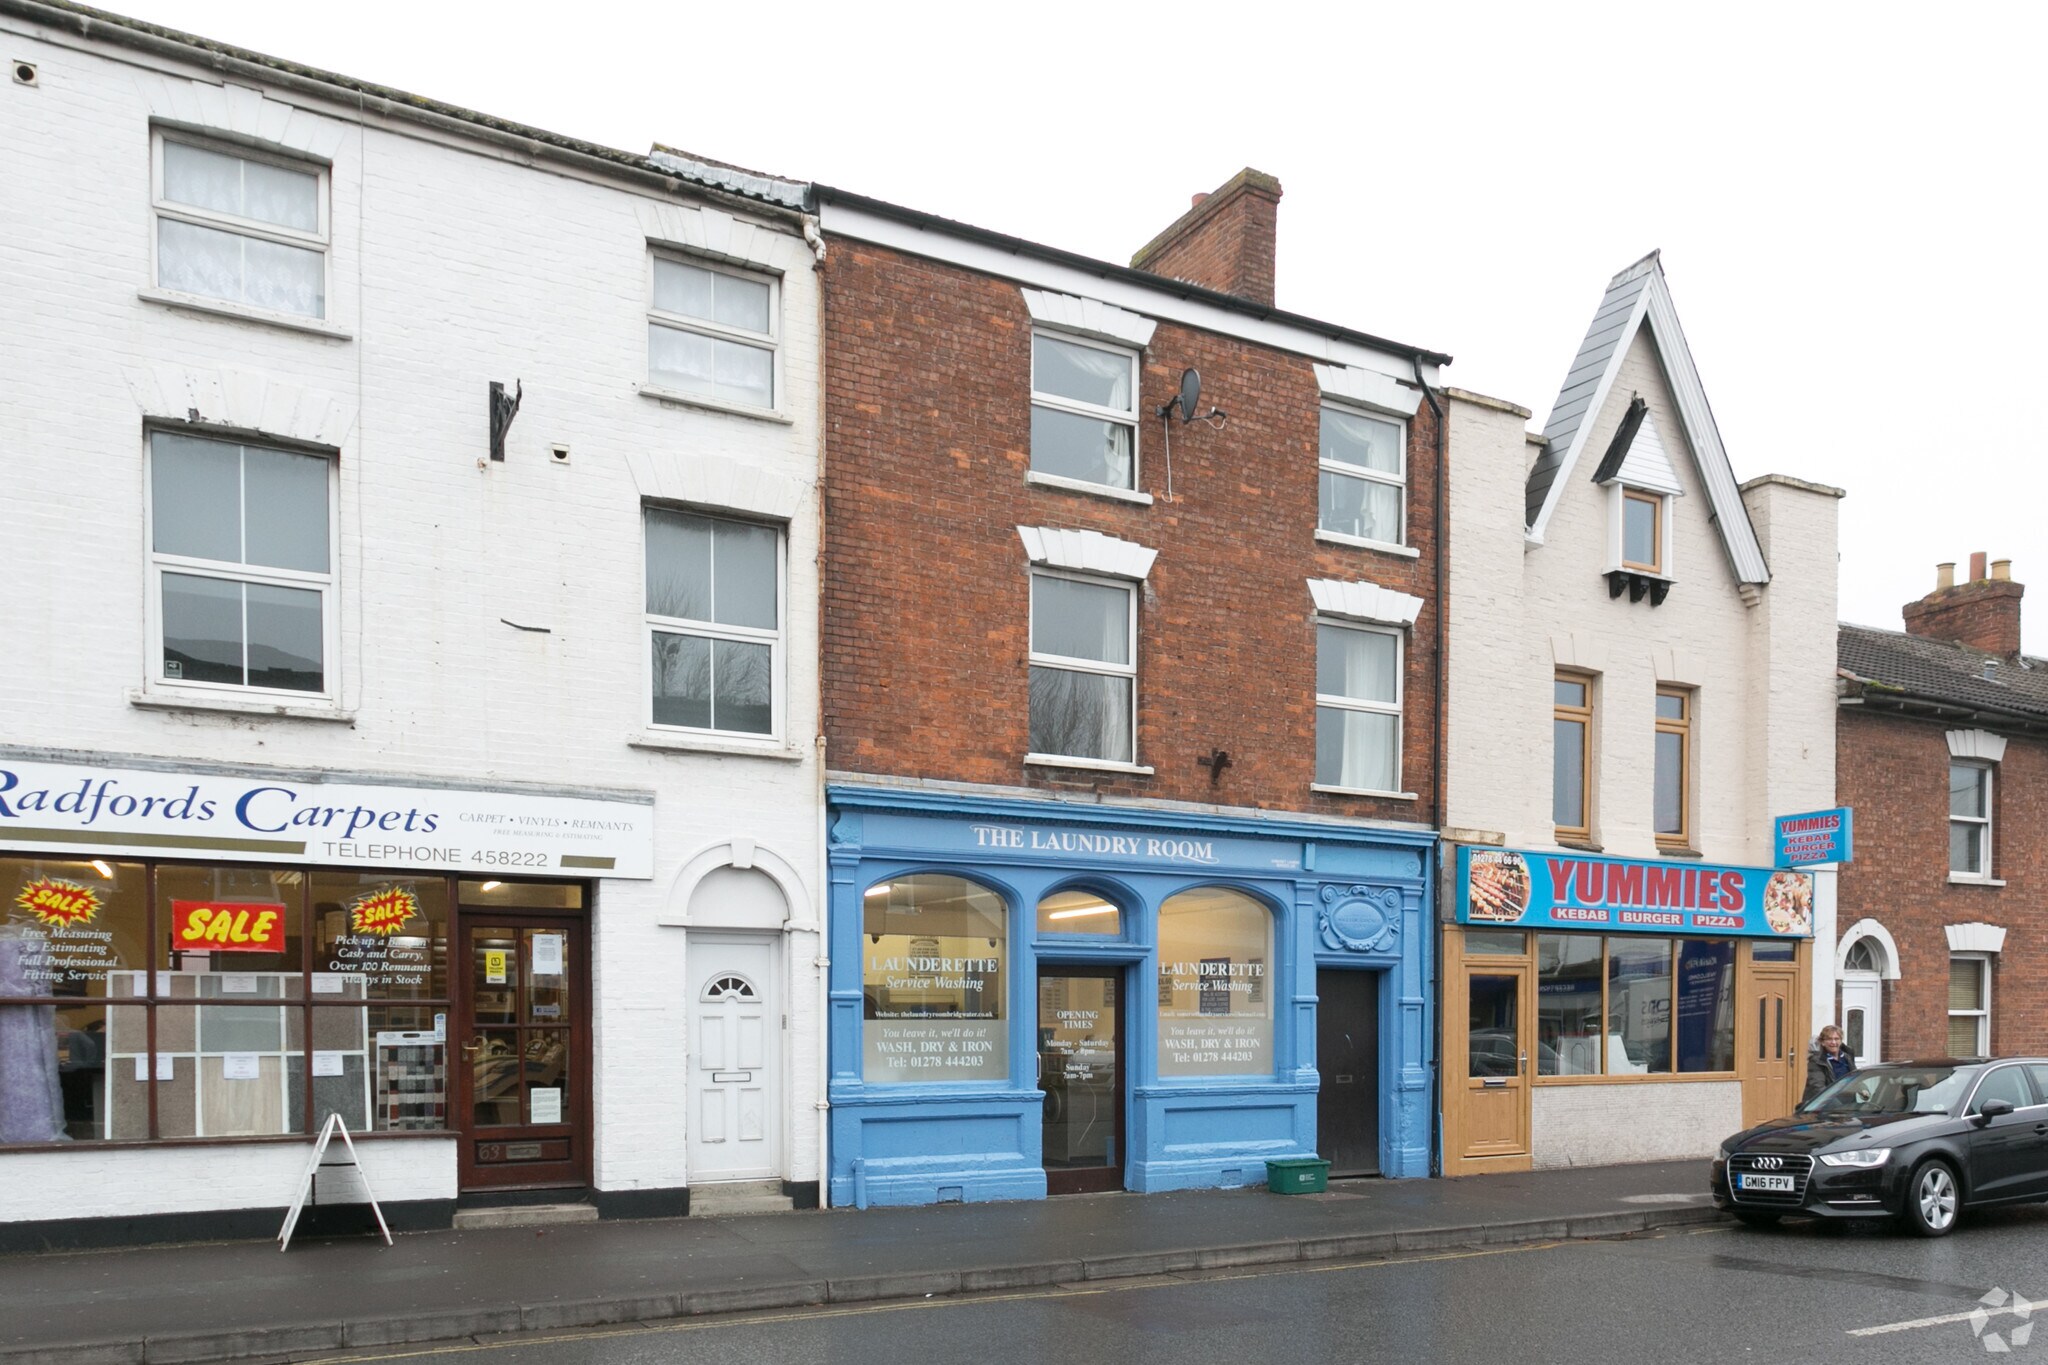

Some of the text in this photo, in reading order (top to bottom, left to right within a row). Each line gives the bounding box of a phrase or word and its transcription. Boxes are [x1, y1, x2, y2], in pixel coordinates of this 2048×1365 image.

[235, 787, 439, 838] Carpets
[459, 812, 634, 832] CARPET VINYLS REMNANTS
[1781, 814, 1840, 834] YUMMIES
[513, 829, 553, 838] MEASURING
[562, 832, 603, 841] ESTIMATING
[1789, 833, 1831, 845] KEBAB
[970, 825, 1219, 863] THE LAUNDRY ROOM
[1784, 842, 1836, 854] BURGER
[322, 841, 548, 867] TELEPHONE 458222
[1791, 852, 1828, 861] PIZZA
[1546, 858, 1746, 913] YUMMIES
[33, 889, 88, 914] SALE
[364, 899, 404, 924] SALE
[1556, 907, 1737, 928] KEBAB BURGER PIZZA
[182, 908, 278, 943] SALE
[21, 927, 112, 942] Free Measuring
[26, 941, 107, 955] & Estimating
[17, 955, 118, 968] Full Professional
[338, 948, 424, 962] Cash and Carry,
[329, 960, 432, 972] Over 100 Remnants
[871, 957, 998, 972] LAUNDERETTE
[1161, 961, 1264, 976] LAUNDERETTE
[23, 969, 108, 982] Fitting Servic
[381, 975, 392, 984] in
[395, 974, 423, 984] Stock
[885, 975, 984, 992] Service Washing
[1172, 978, 1254, 993] Service Washing
[875, 1010, 899, 1018] Website:
[1056, 1010, 1099, 1019] OPENING
[1063, 1020, 1093, 1029] TIMES
[1170, 1026, 1255, 1036] You leave it, we'll do it!
[883, 1028, 987, 1038] You leave it, we'll do it!
[876, 1040, 993, 1053] WASH, DRY & IRON
[1046, 1039, 1072, 1048] Monday
[1079, 1039, 1109, 1048] Saturday
[1165, 1038, 1261, 1050] WASH, DRY & IRON
[886, 1055, 984, 1068] Tel: 01278 444203
[1172, 1052, 1253, 1063] Tel: 01278 444203
[1065, 1063, 1090, 1072] Sunday
[479, 1144, 500, 1160] 63
[1745, 1176, 1789, 1189] GM16 FPV
